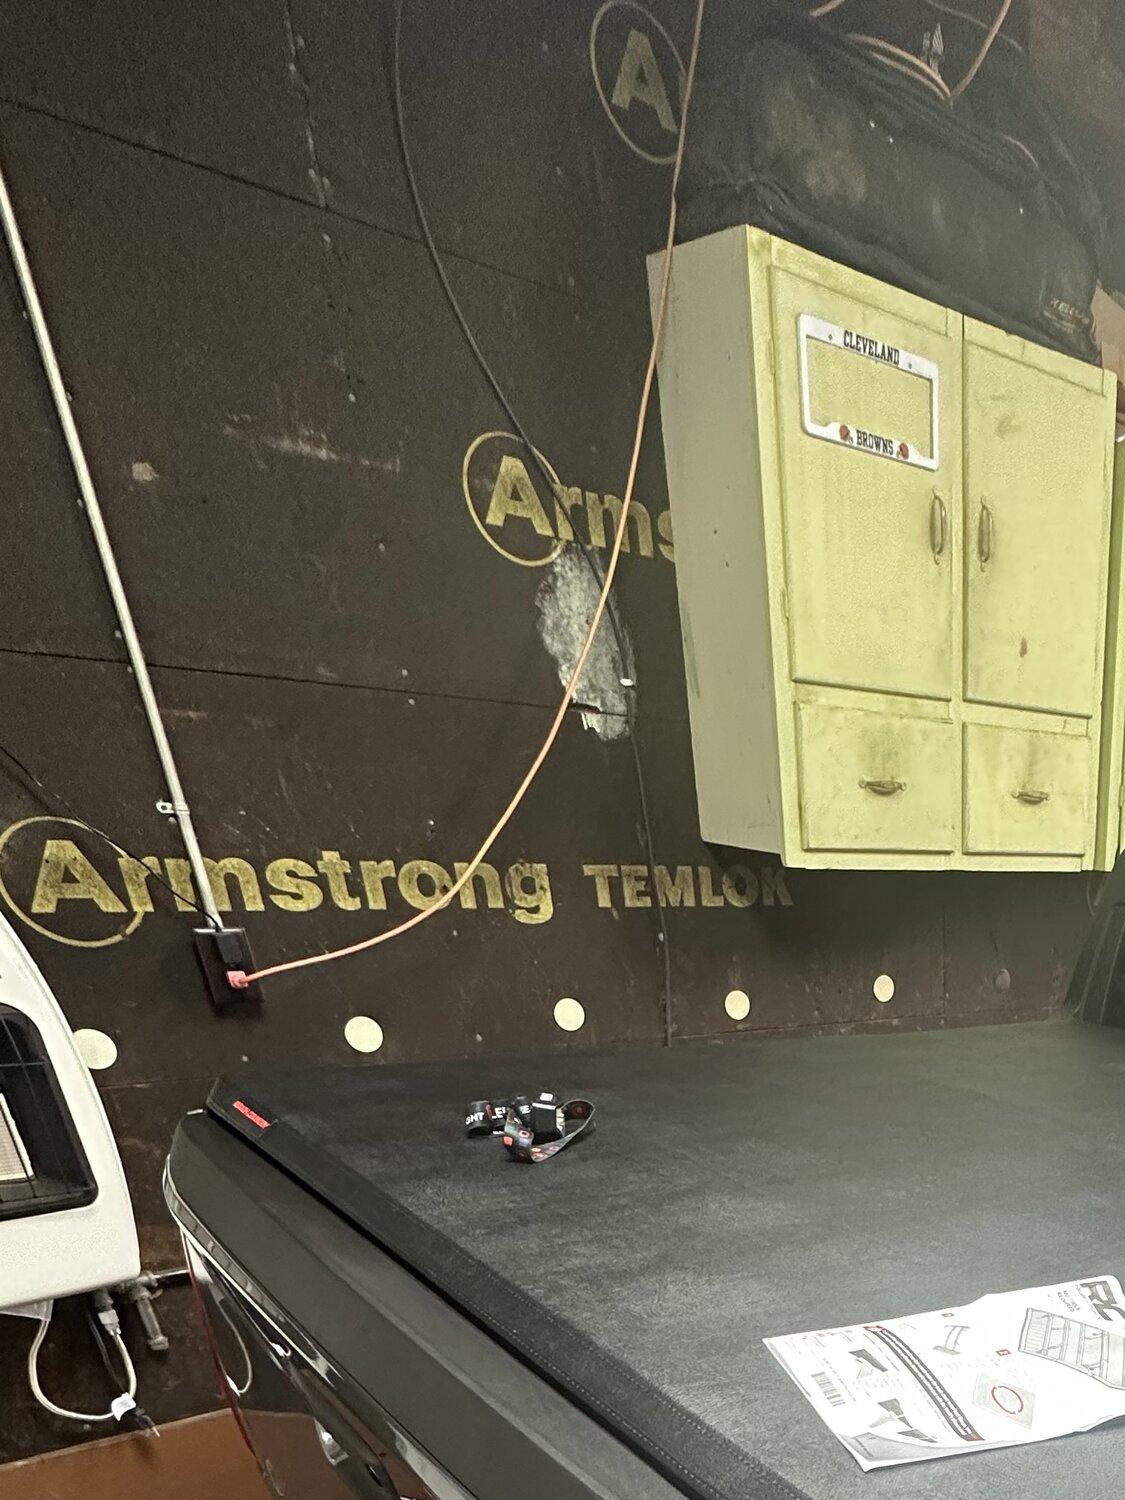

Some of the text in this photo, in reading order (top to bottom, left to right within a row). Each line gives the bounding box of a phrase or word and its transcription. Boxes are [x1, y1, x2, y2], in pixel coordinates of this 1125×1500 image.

[843, 329, 900, 366] CLEVELAND
[856, 429, 894, 456] BROWNS
[31, 839, 793, 924] Armstrong TEMLOK
